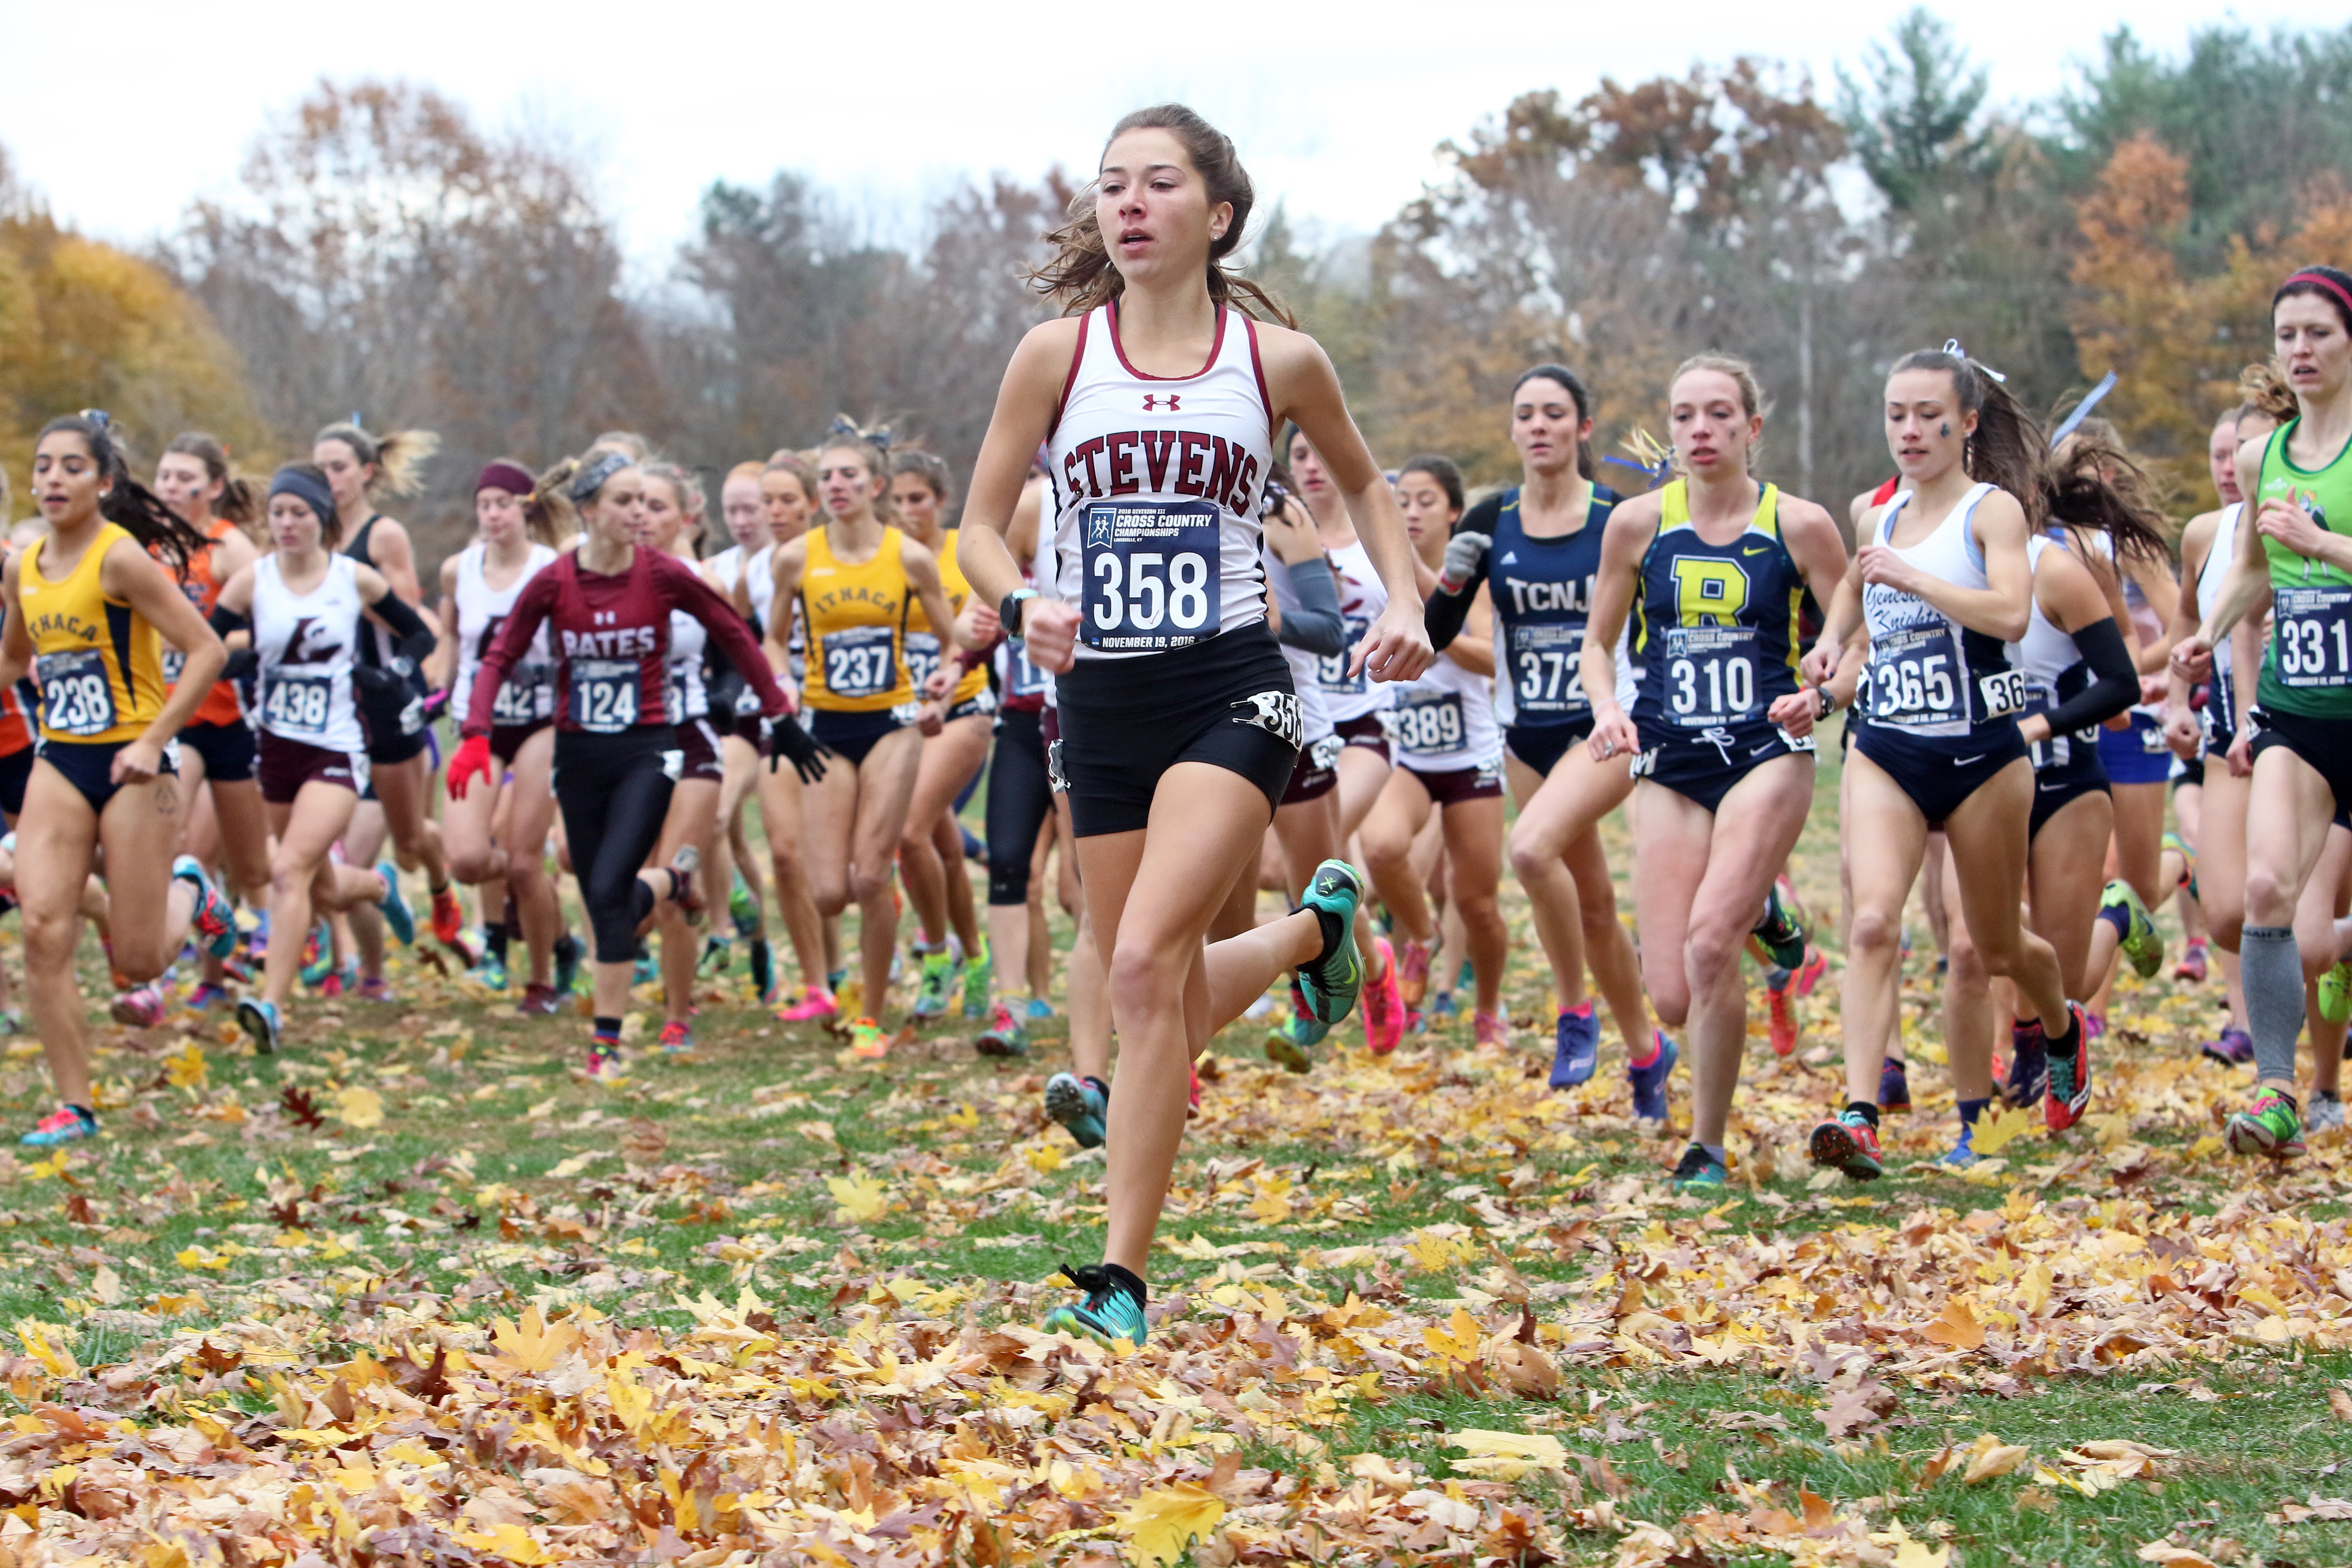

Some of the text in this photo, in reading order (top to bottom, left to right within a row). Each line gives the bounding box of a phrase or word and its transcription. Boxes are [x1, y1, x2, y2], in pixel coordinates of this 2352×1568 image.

[1064, 429, 1258, 518] STEVENS
[1115, 528, 1179, 537] CHAMPIONSHIPS
[1116, 514, 1213, 527] CROSS COUNTRY
[815, 587, 896, 616] ITHACA
[1093, 552, 1207, 630] 358
[1506, 574, 1595, 615] TCNJ
[1670, 554, 1751, 628] R
[29, 613, 97, 641] THACA
[1874, 605, 1942, 631] Knights
[561, 625, 655, 658] BATES
[1102, 636, 1195, 648] NOVEMBER 19, 2016
[2282, 619, 2349, 674] 331
[829, 646, 889, 689] 237
[1520, 652, 1587, 700] 372
[1672, 657, 1753, 714] 310
[1878, 654, 1954, 716] 365
[48, 674, 111, 729] 238
[266, 681, 328, 726] 438
[493, 681, 533, 716] 42
[579, 682, 635, 723] 124
[1262, 693, 1302, 748] 358
[1399, 703, 1461, 748] 389
